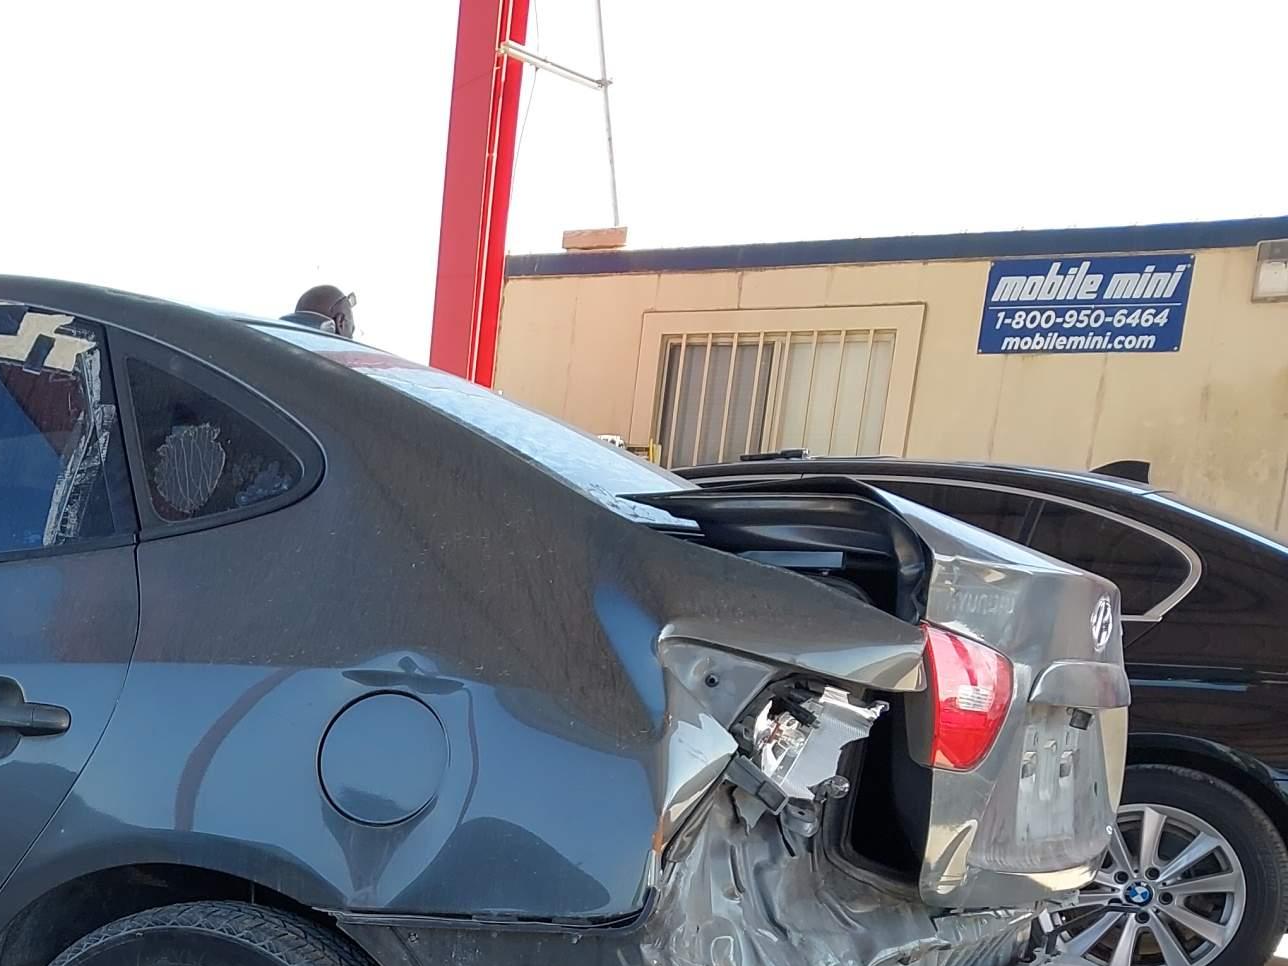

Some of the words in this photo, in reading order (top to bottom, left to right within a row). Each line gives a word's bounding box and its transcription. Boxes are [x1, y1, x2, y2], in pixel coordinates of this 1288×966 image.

[991, 261, 1104, 302] mobile
[1103, 264, 1187, 300] mini
[994, 308, 1170, 330] 1-800-950-6464
[1001, 332, 1156, 351] mobilemini.com
